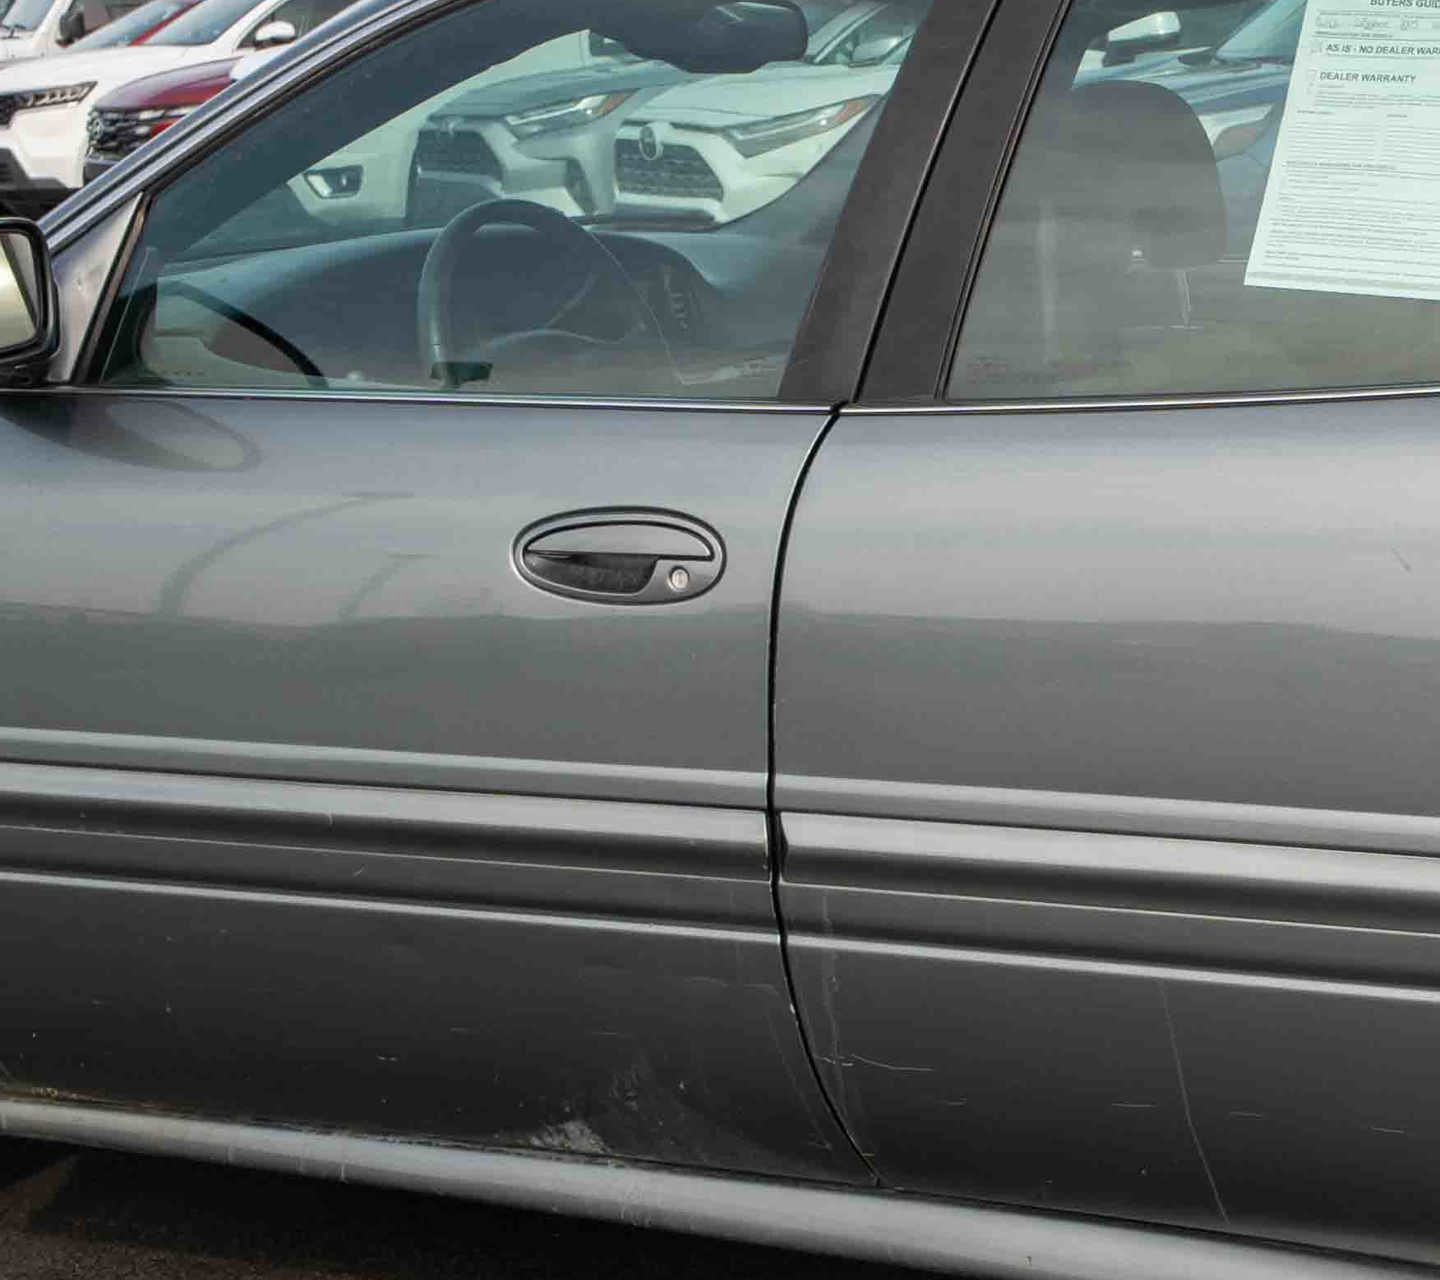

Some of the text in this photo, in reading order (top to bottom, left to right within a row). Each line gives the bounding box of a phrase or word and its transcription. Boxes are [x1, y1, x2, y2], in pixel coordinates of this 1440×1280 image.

[1326, 43, 1339, 53] AS
[1342, 43, 1351, 54] IS
[1359, 44, 1373, 54] NO
[1376, 45, 1414, 55] DEALER
[1320, 70, 1417, 83] DEALER WARRANTY
